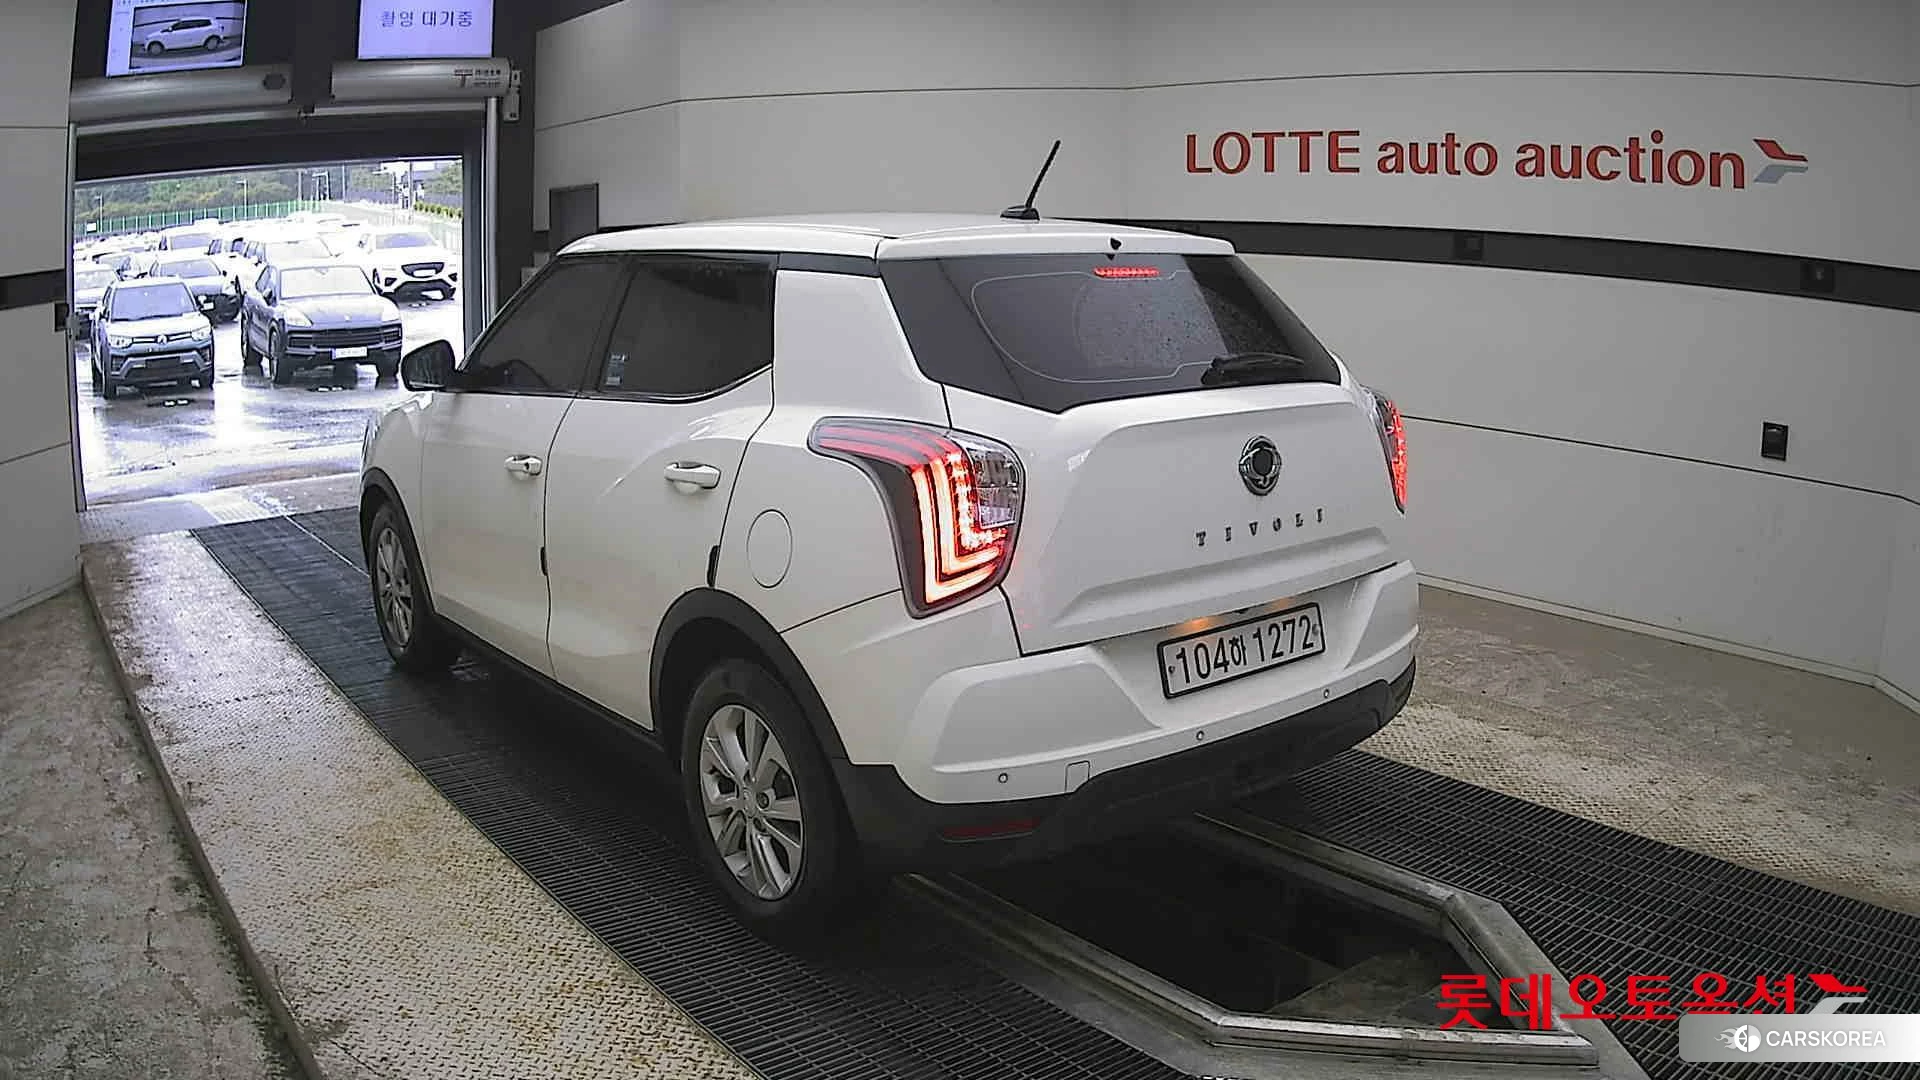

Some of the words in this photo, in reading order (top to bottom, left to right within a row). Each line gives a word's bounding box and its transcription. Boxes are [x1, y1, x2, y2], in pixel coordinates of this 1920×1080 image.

[422, 10, 473, 28] 대기중
[1185, 130, 1361, 174] LOTTE
[1376, 131, 1498, 176] auto
[1514, 130, 1745, 189] auction
[1195, 508, 1325, 547] TIVOLI
[1175, 634, 1247, 685] 104하
[1252, 614, 1314, 663] 1272
